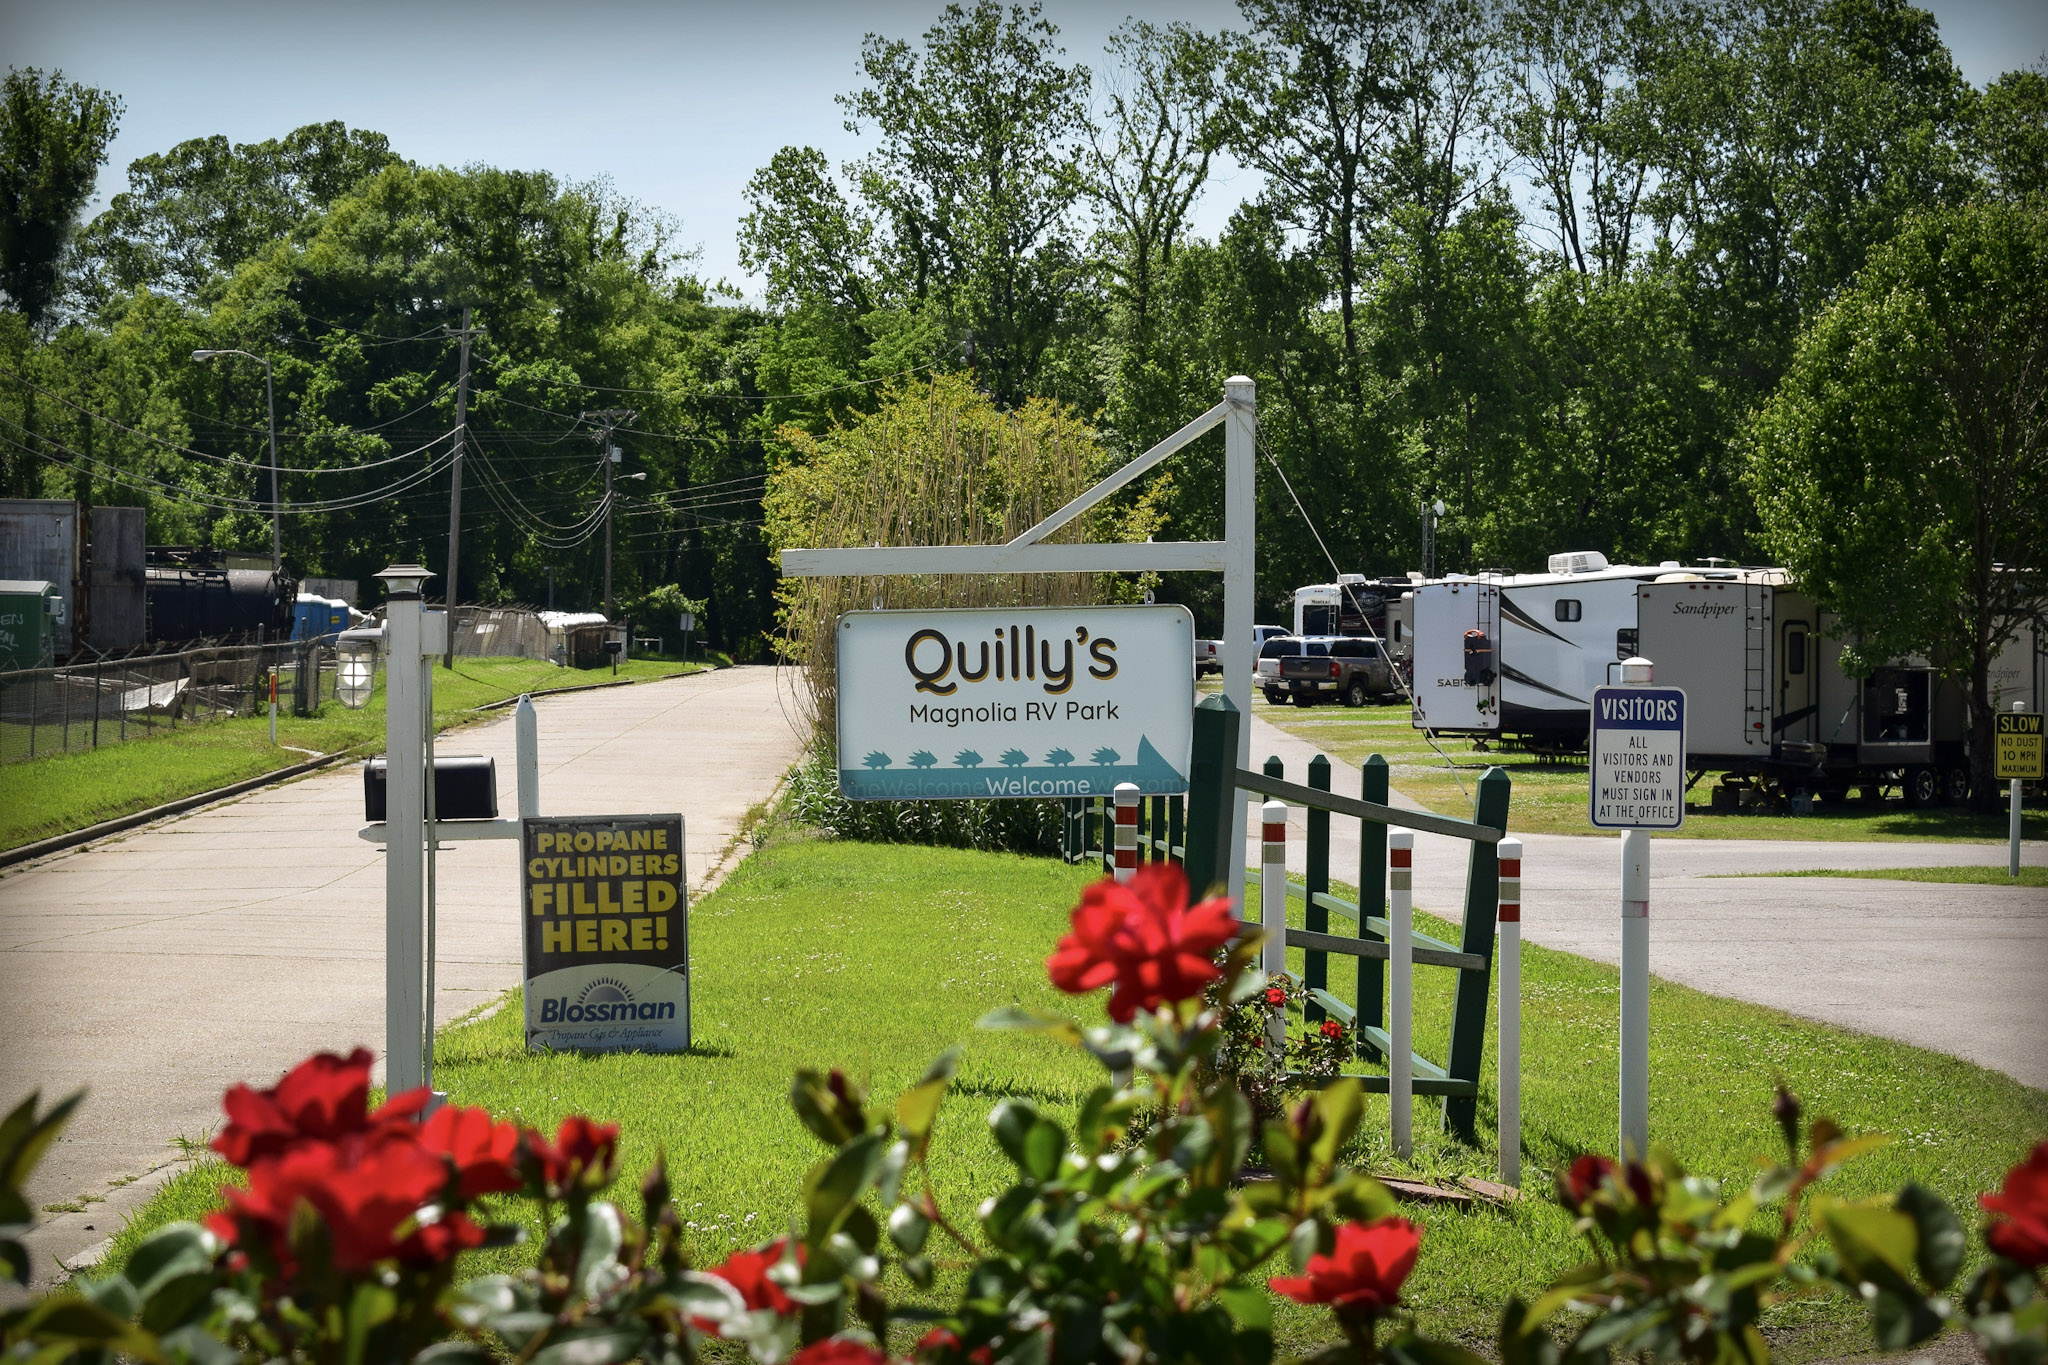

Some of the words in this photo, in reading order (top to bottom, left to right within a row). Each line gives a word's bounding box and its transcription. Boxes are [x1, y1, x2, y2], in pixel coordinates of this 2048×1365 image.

[1673, 601, 1738, 619] Sandpiper
[905, 624, 1118, 696] Quilly's
[1437, 678, 1469, 687] SABR
[910, 702, 1017, 727] Magnolia
[1026, 702, 1057, 721] RV
[1066, 700, 1119, 721] Park
[1601, 697, 1677, 721] VISITORS
[2001, 716, 2040, 732] SLOW
[1629, 736, 1647, 748] ALL
[2001, 738, 2013, 747] NO
[2017, 738, 2038, 747] DUST
[1603, 753, 1648, 766] VISITORS
[1652, 754, 1673, 767] AND
[2003, 751, 2015, 760] 10
[2020, 751, 2036, 761] MPH
[1614, 770, 1661, 784] VENDORS
[2002, 765, 2037, 773] MAXIMUM
[985, 776, 1091, 795] Welcome
[1602, 788, 1628, 800] MUST
[1633, 788, 1657, 801] SIGN
[1662, 789, 1672, 801] IN
[1600, 805, 1611, 817] AT
[1616, 805, 1634, 818] THE
[1638, 806, 1674, 819] OFFICE
[537, 829, 667, 853] PROPANE
[528, 854, 679, 878] CYLINDERS
[531, 880, 677, 916] FILLED
[542, 916, 668, 953] HERE!
[540, 996, 675, 1024] Blossman
[551, 1028, 587, 1042] Propane
[608, 1026, 618, 1038] &
[620, 1026, 663, 1040] Appliance
